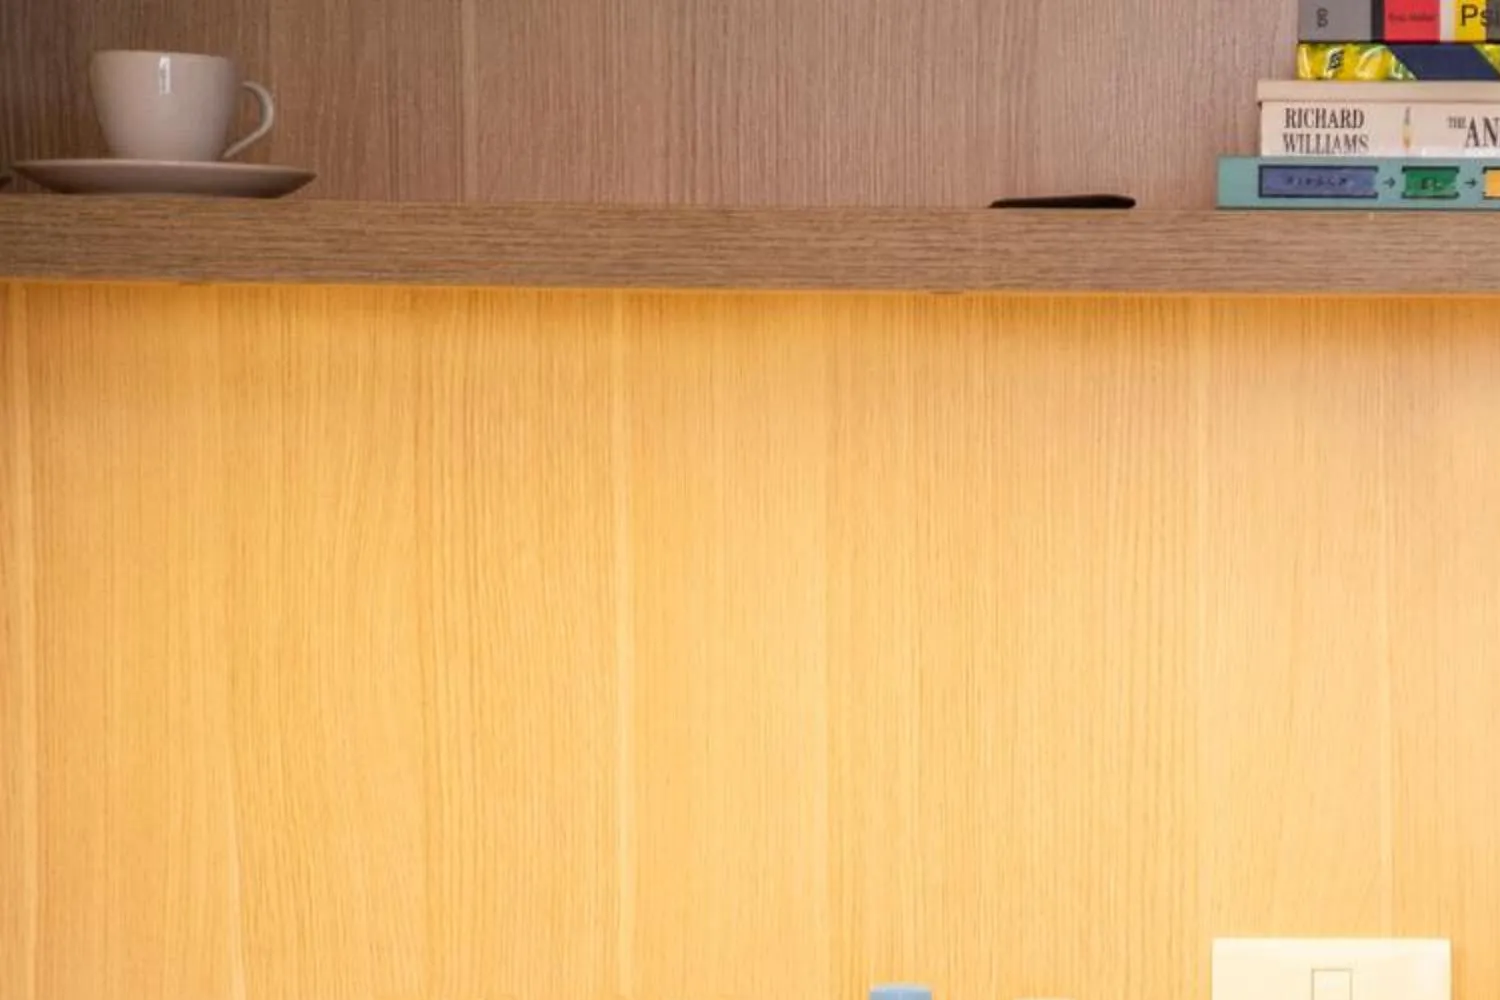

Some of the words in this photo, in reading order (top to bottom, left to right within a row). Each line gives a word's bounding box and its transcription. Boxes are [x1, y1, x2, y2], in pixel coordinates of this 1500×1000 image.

[1284, 107, 1366, 129] RICHARD
[1447, 115, 1467, 129] THE
[1282, 133, 1370, 154] WILLIAMS
